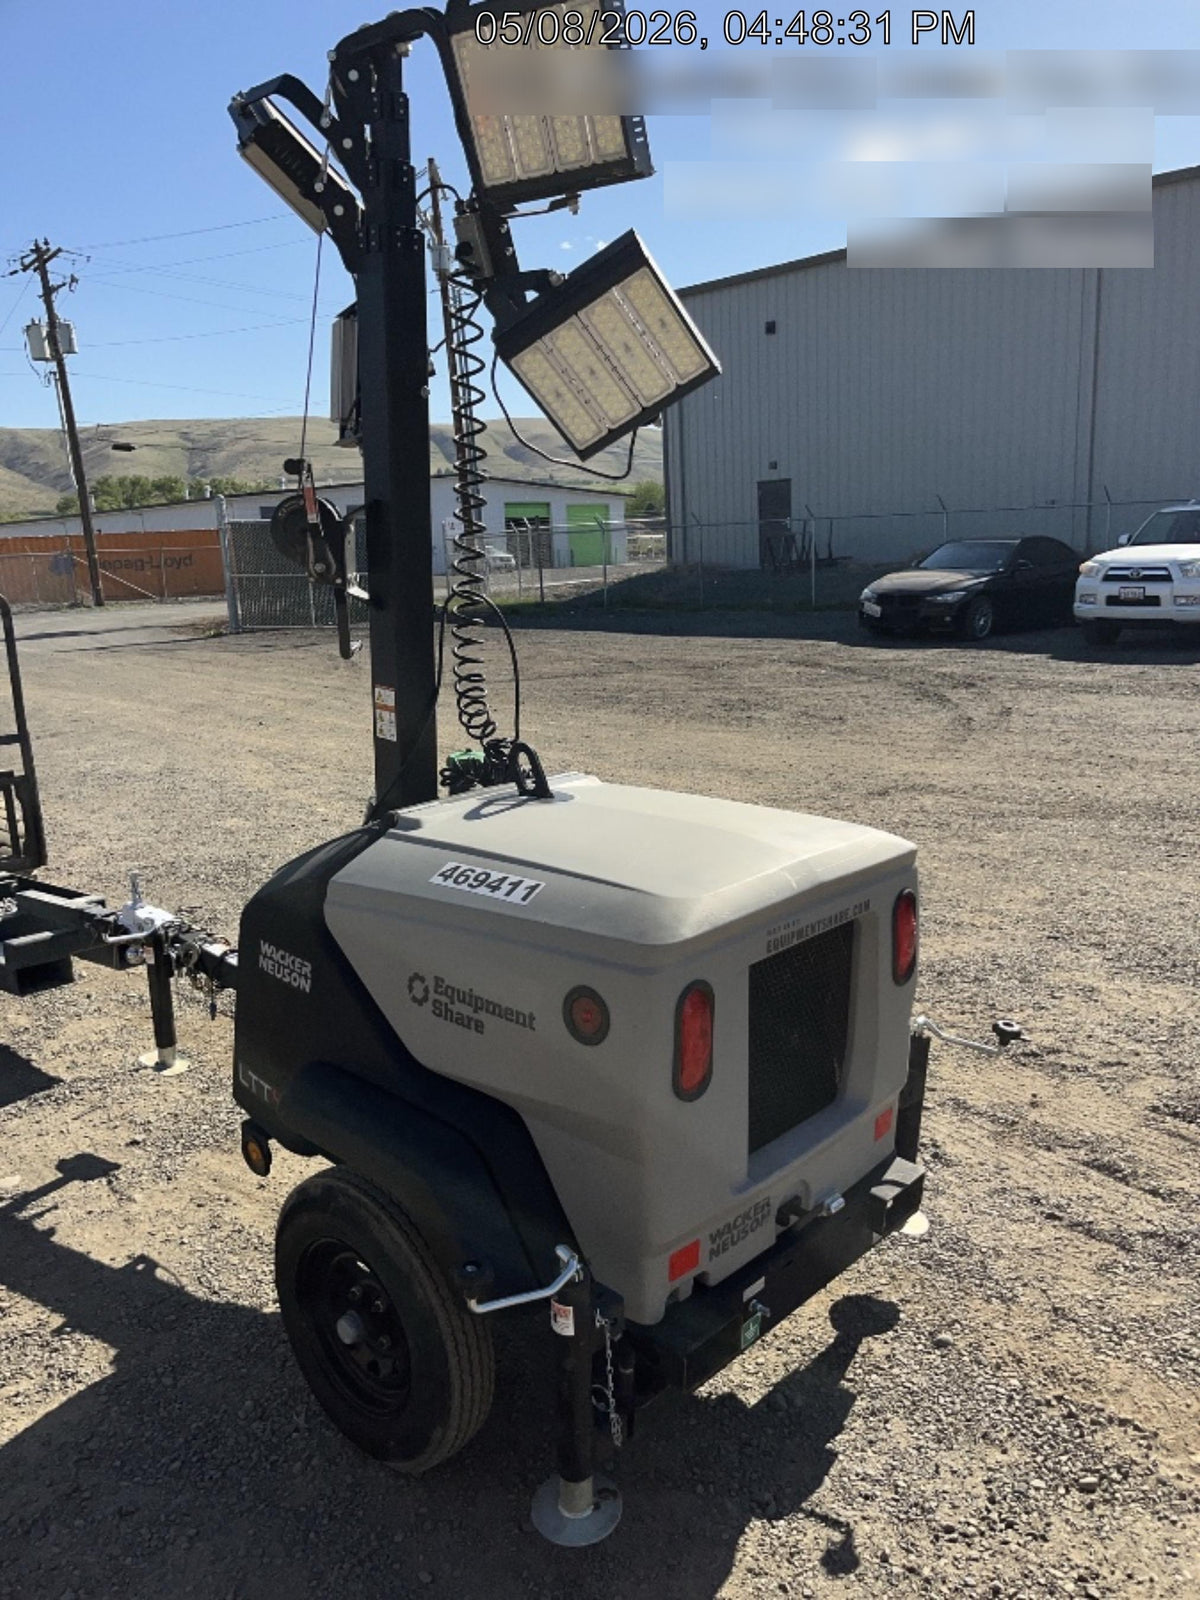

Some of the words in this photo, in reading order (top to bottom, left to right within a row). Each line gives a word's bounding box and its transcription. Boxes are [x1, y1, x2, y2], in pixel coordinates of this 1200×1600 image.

[436, 864, 542, 902] 469411
[259, 956, 312, 994] NEUSON
[260, 939, 312, 976] WACKER
[432, 1001, 485, 1035] Share
[433, 975, 536, 1032] Equipment
[709, 1196, 770, 1245] WACKER
[709, 1208, 770, 1262] NEUSON
